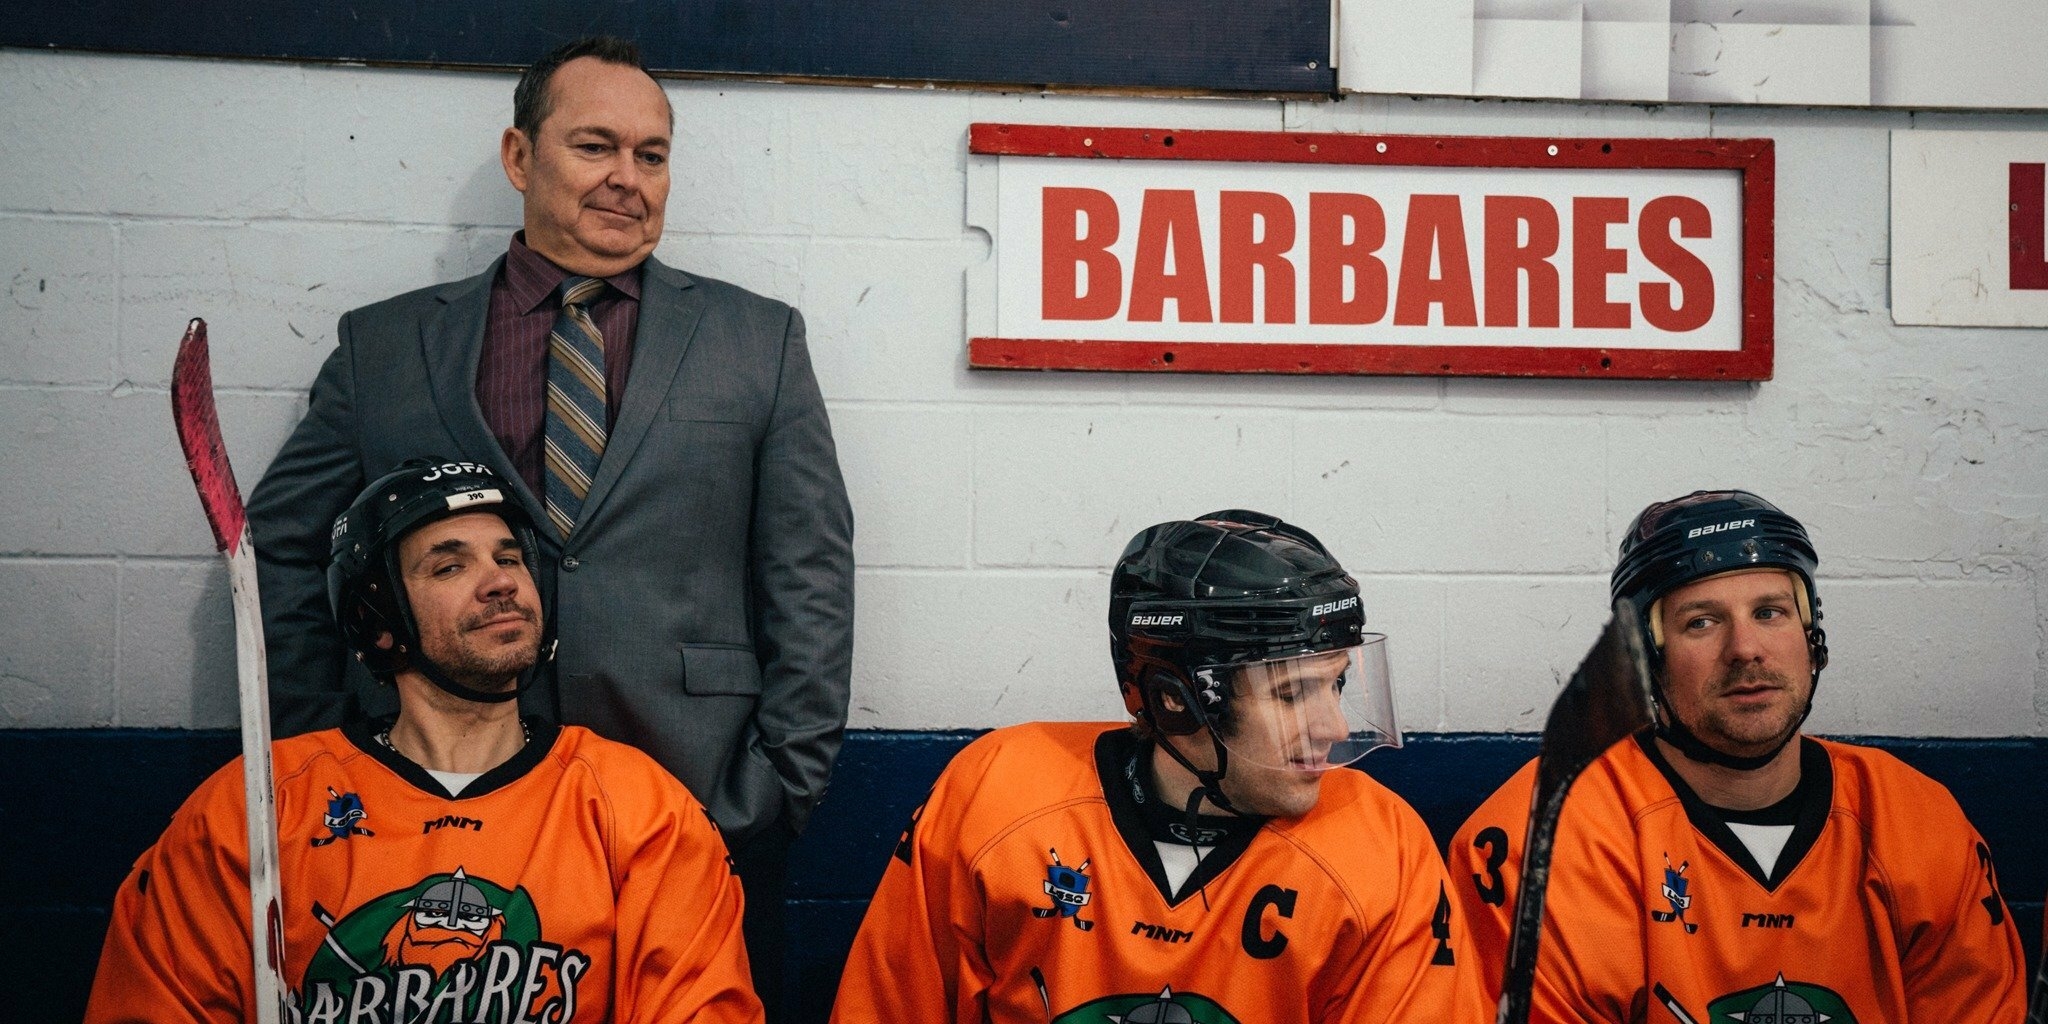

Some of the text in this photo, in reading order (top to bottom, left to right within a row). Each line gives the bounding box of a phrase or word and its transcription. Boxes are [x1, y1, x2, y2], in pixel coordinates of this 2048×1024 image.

[1042, 186, 1715, 333] BARBARES
[423, 462, 494, 481] JOFA
[467, 492, 484, 501] 390
[1688, 518, 1756, 539] BAUER
[1312, 596, 1358, 617] BAUER
[1131, 614, 1184, 626] BAUER
[422, 815, 484, 835] MNM
[1472, 826, 1509, 909] 3
[1241, 884, 1298, 960] C
[1740, 912, 1796, 929] MNM
[1130, 920, 1195, 944] MNM
